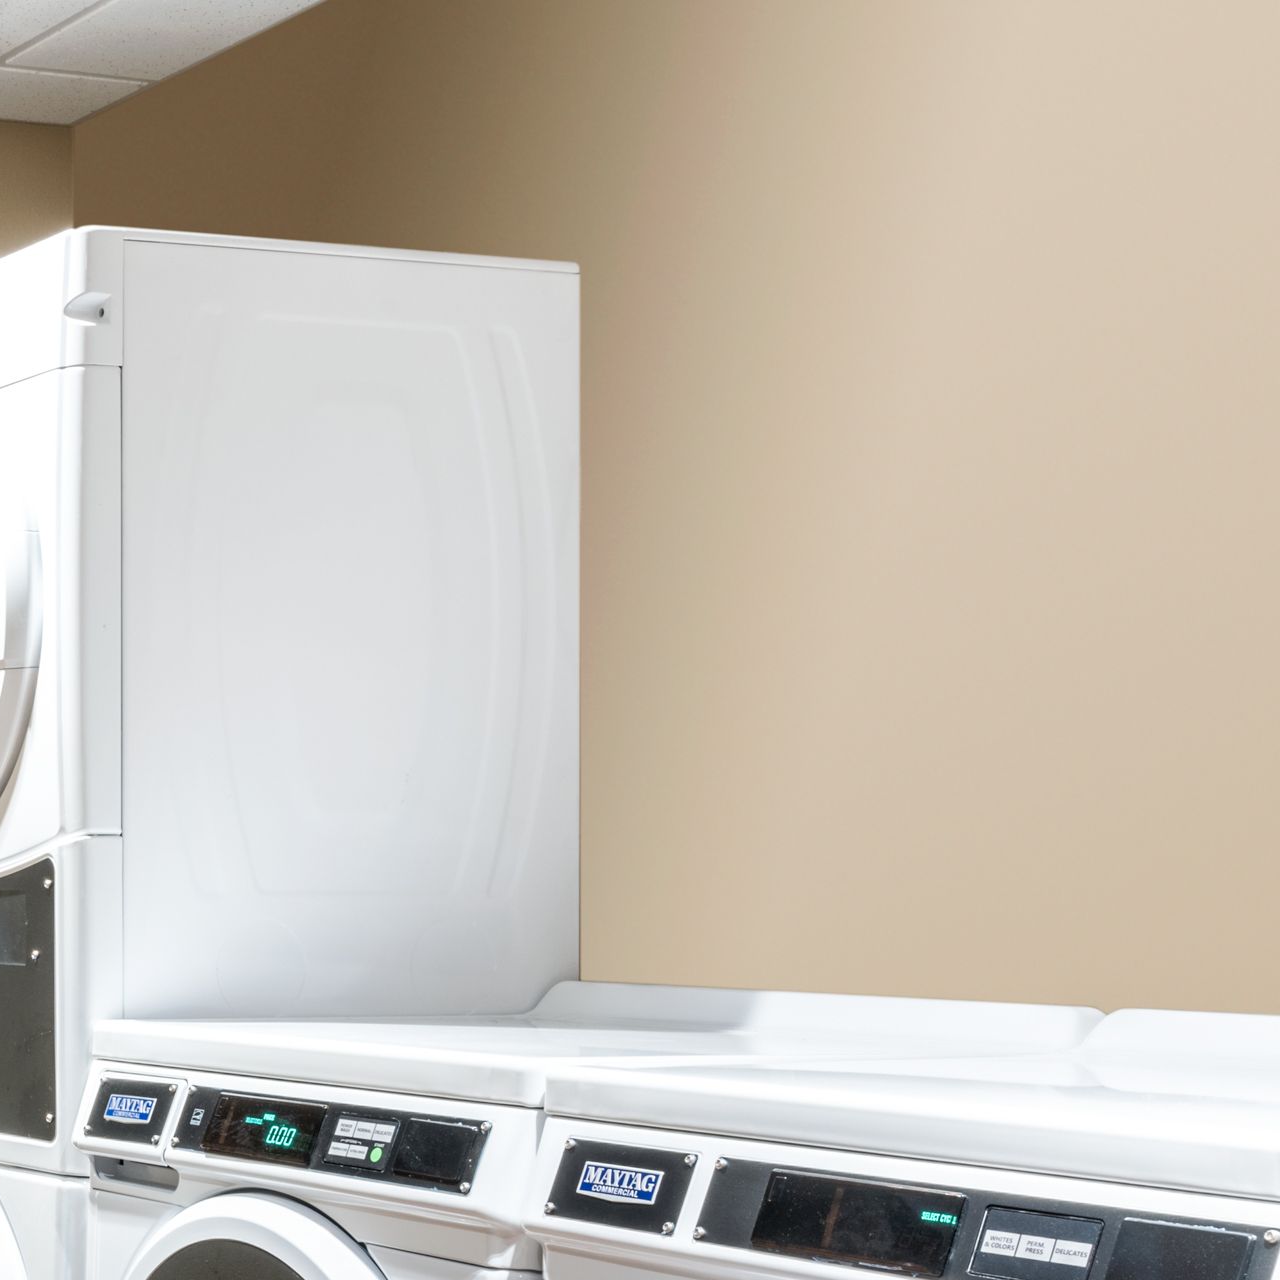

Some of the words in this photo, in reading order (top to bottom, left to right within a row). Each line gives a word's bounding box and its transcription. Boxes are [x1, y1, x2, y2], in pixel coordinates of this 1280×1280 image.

[108, 1097, 152, 1114] MAYTAG
[583, 1166, 656, 1192] MAYTAG
[591, 1184, 638, 1198] COMMERCIAL
[990, 1235, 1013, 1243] WHITES
[990, 1243, 1015, 1251] COLORS
[1025, 1247, 1044, 1255] PRESS
[1055, 1248, 1088, 1258] DELICATES
